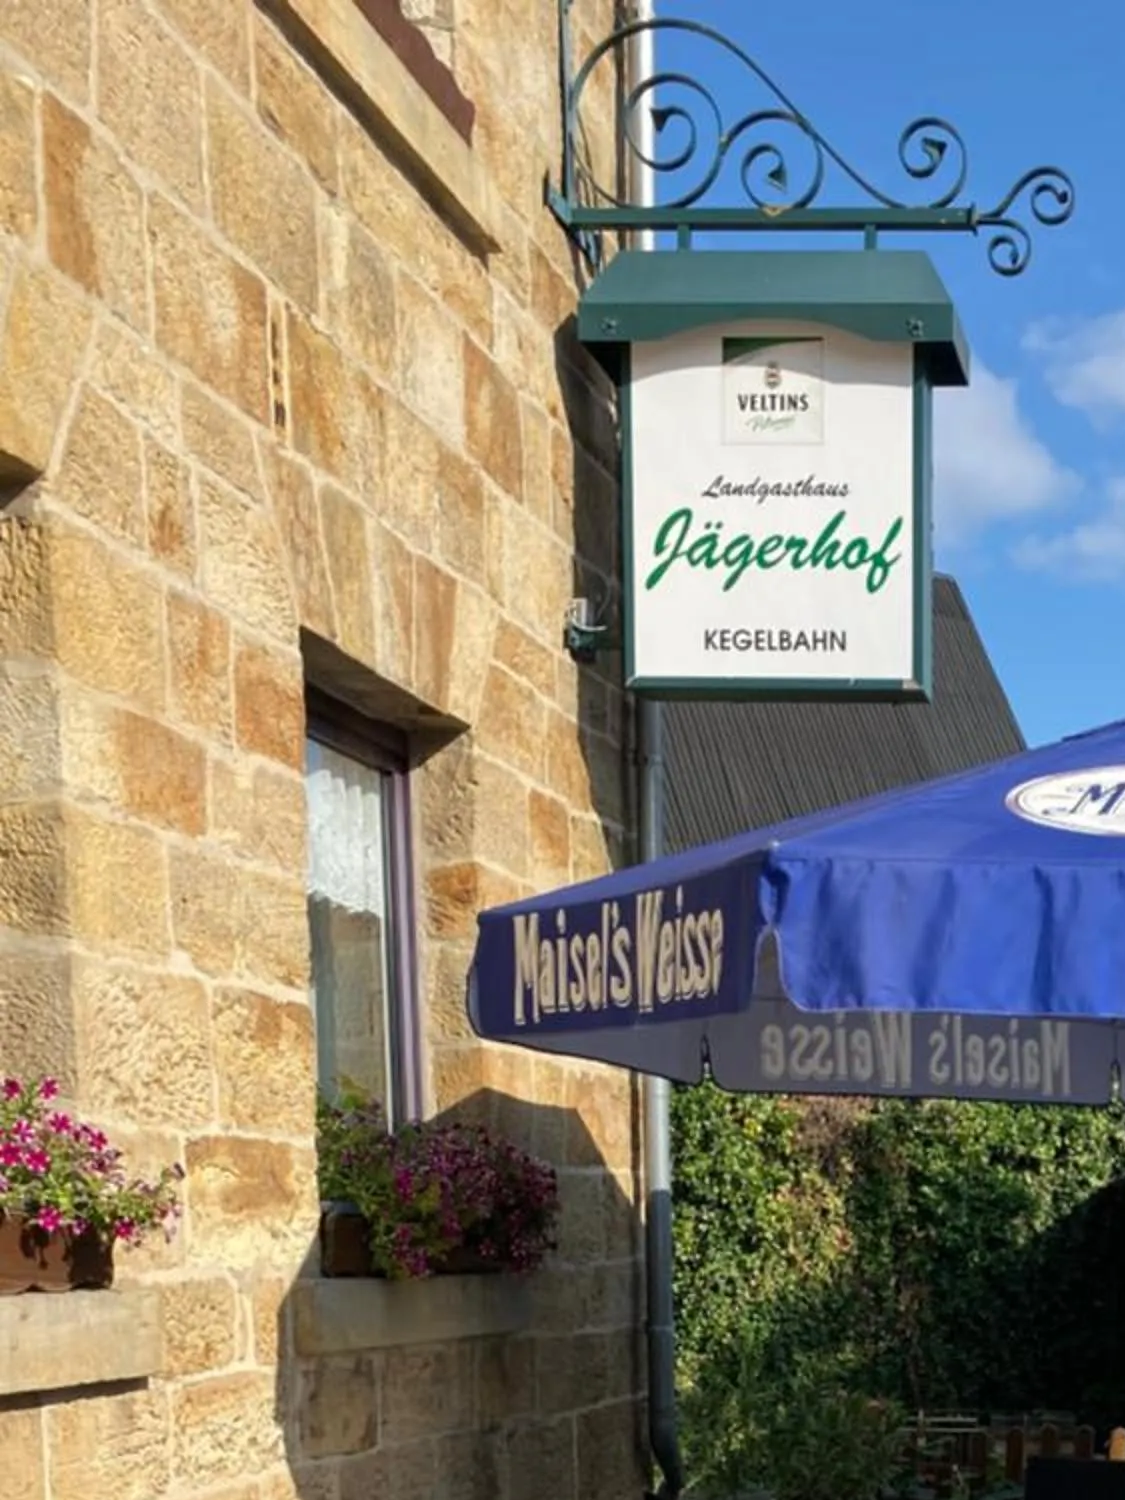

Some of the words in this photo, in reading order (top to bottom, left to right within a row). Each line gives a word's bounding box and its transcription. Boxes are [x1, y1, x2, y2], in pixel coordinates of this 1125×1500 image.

[737, 393, 809, 412] VELTINS
[702, 475, 851, 504] Landgasthaus
[645, 507, 904, 594] Jägerhof
[703, 629, 847, 652] KEGELBAHN
[513, 901, 632, 1026] Maisel's
[636, 885, 725, 1013] Weisse
